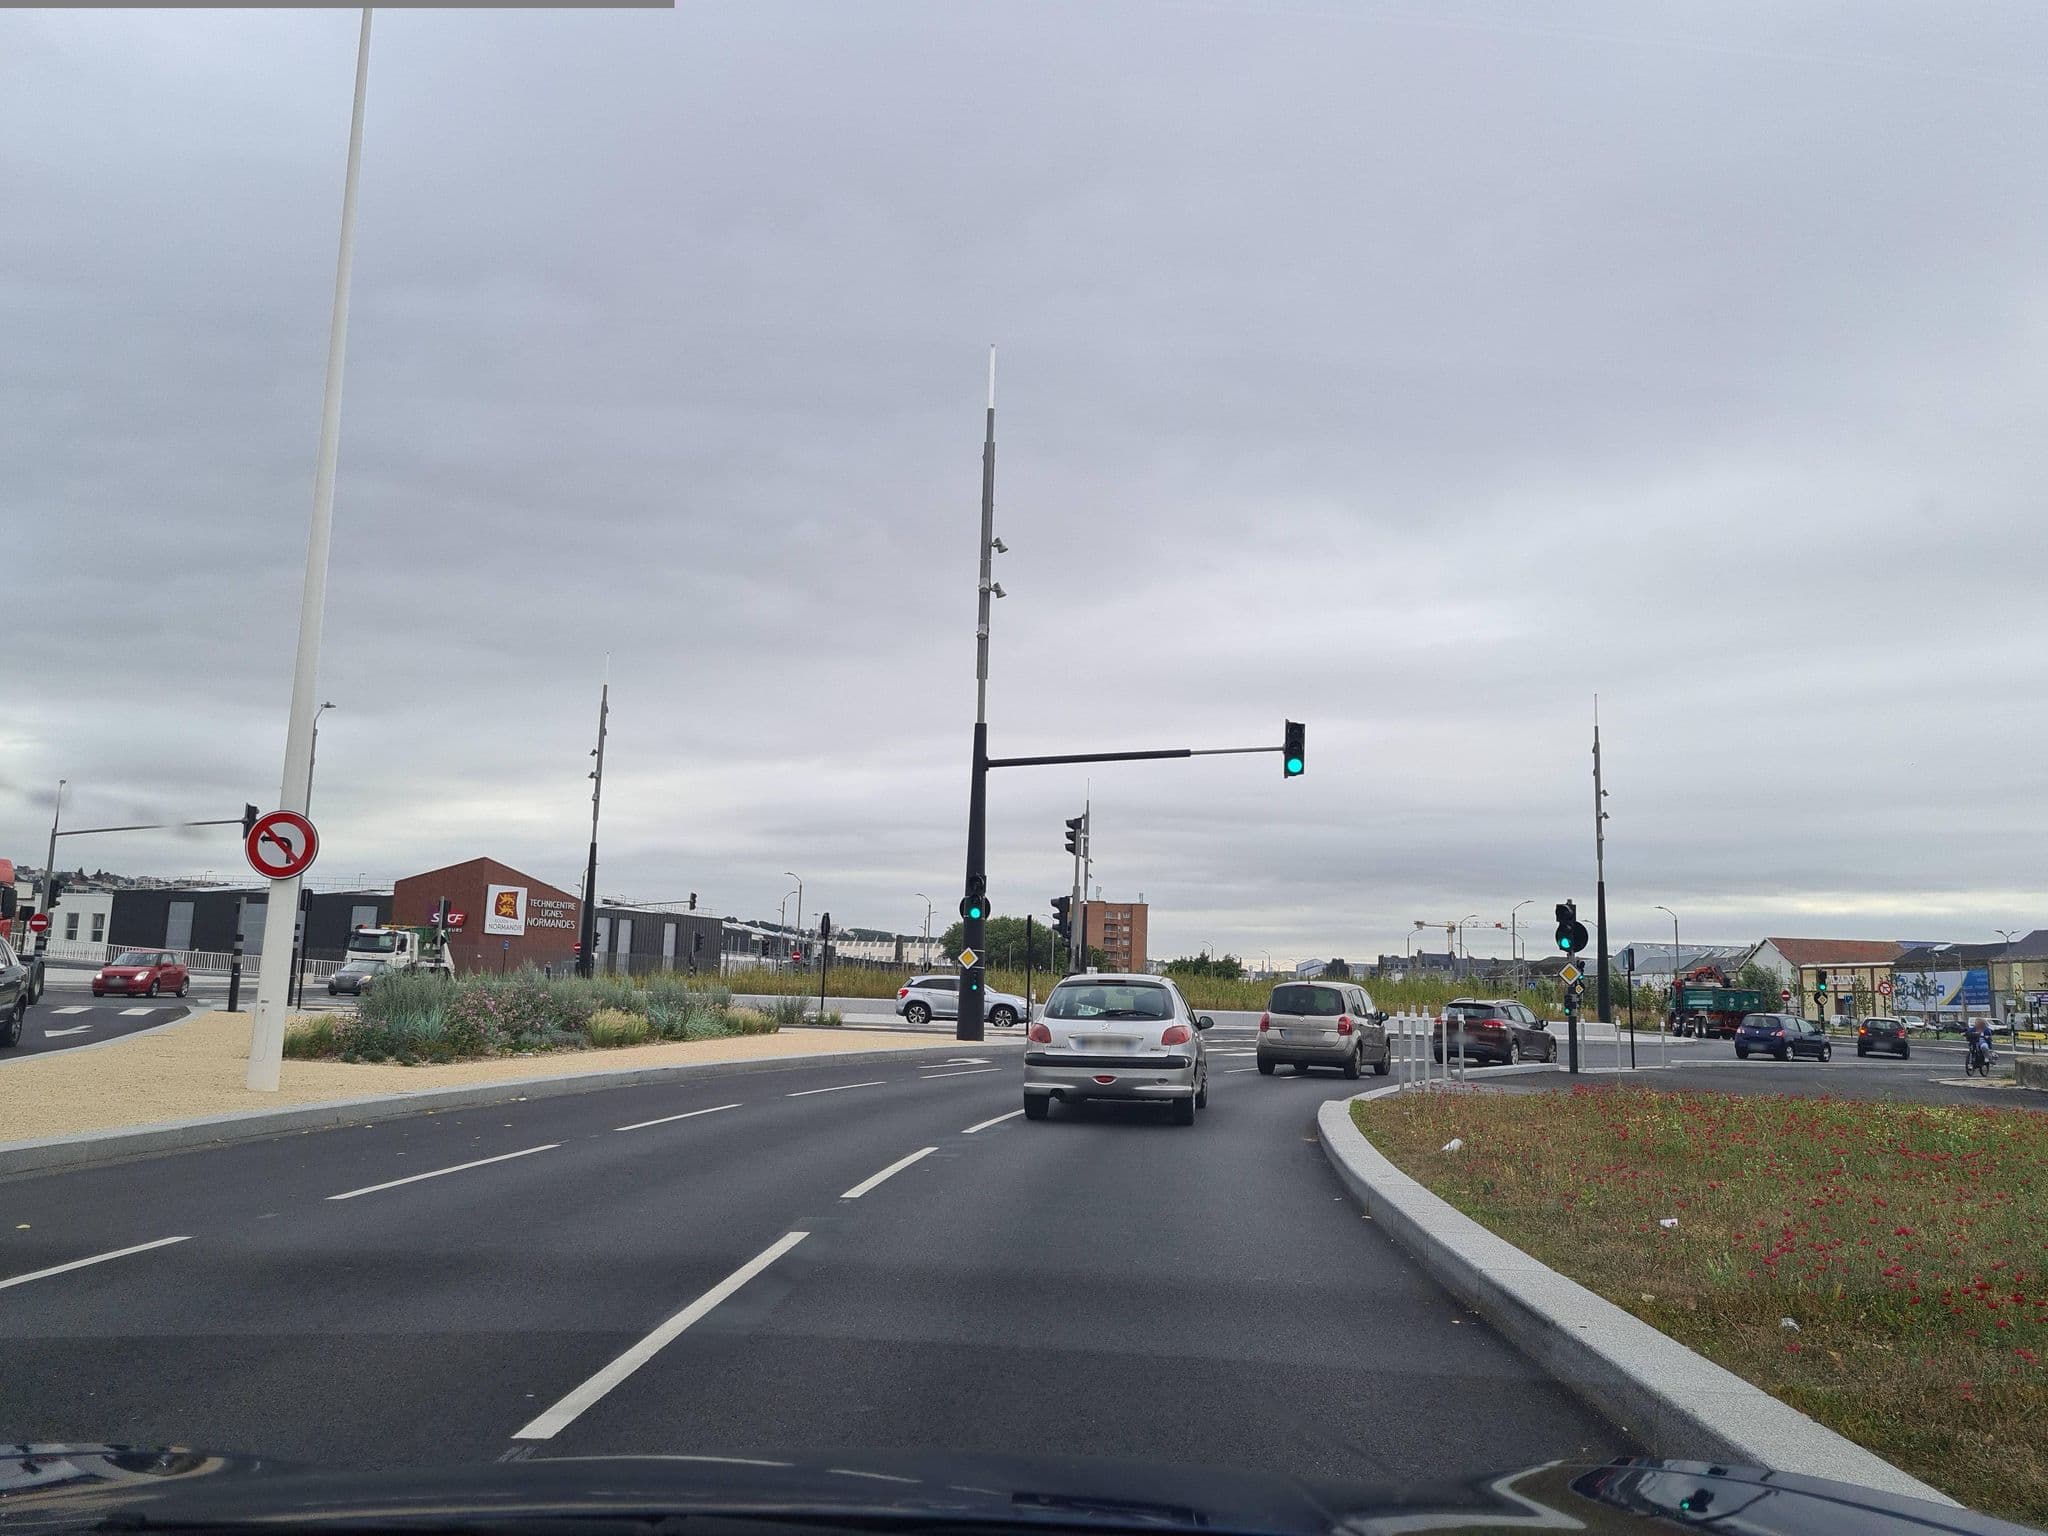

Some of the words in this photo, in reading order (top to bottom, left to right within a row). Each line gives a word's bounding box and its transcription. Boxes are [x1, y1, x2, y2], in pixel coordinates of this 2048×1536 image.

[530, 898, 576, 911] TECHNICENTRE
[430, 912, 464, 924] SCF
[541, 909, 564, 918] LIGNES
[488, 923, 523, 931] NORMANDIE
[527, 917, 576, 930] NORMANDES
